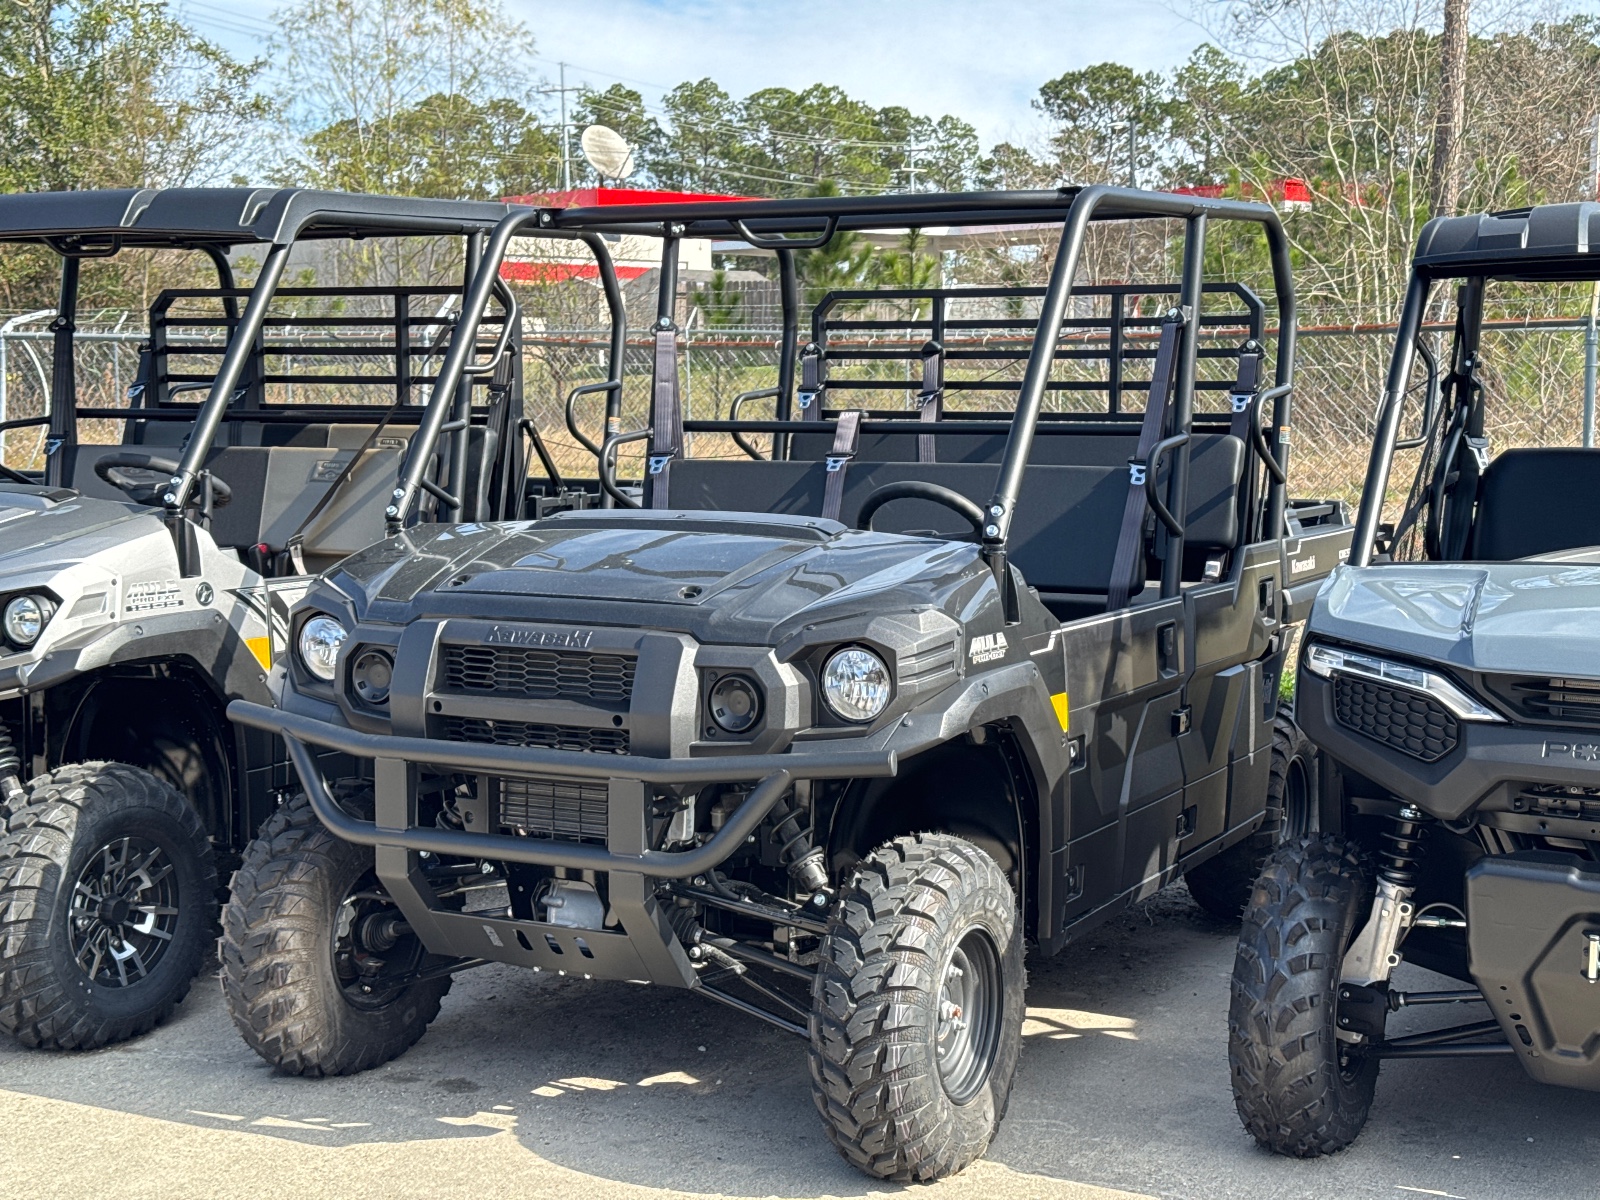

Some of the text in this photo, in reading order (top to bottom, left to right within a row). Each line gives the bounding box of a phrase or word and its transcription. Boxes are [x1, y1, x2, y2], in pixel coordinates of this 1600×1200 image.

[126, 580, 181, 598] MULE
[132, 594, 176, 604] PRO FXT
[484, 625, 593, 648] Kawasaki
[969, 632, 1008, 657] MULE
